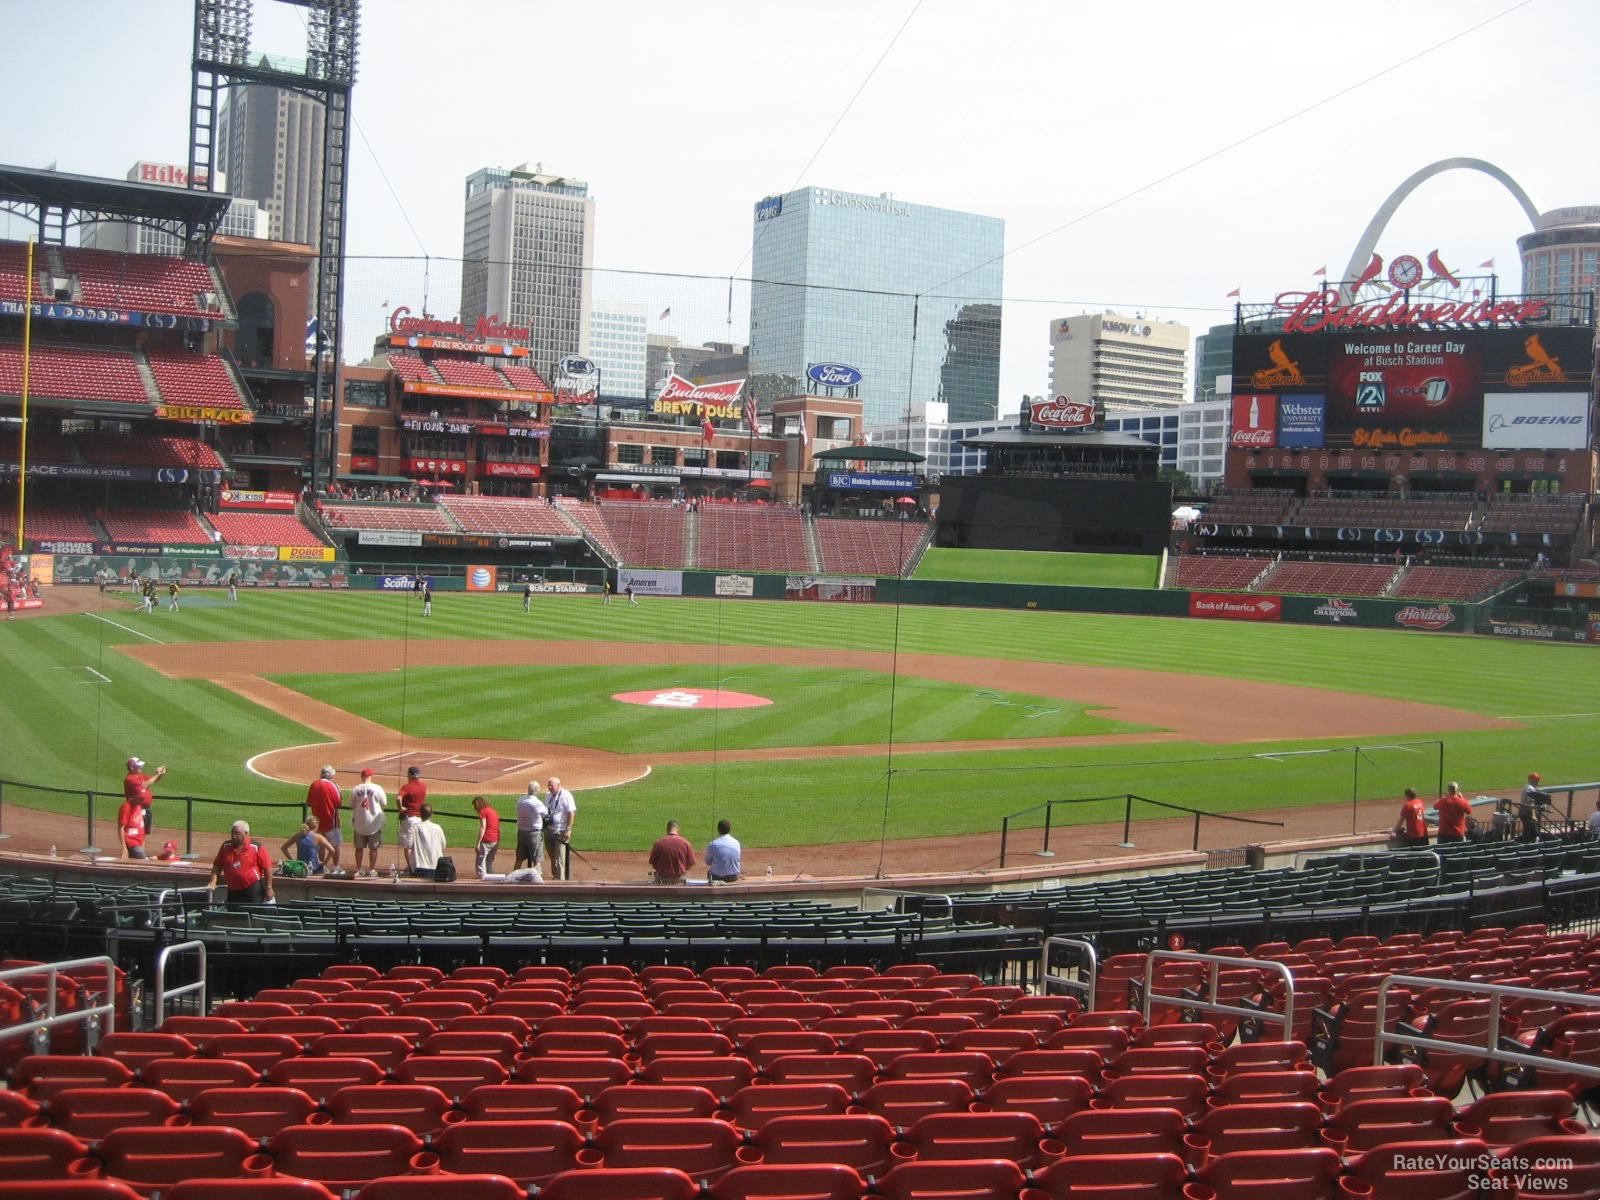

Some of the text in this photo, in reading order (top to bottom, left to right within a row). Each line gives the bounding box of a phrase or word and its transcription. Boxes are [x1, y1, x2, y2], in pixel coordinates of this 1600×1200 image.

[756, 205, 778, 220] KPMG
[48, 306, 55, 316] A
[64, 306, 118, 321] POWER
[1275, 291, 1547, 332] Budweiser
[390, 306, 529, 341] Cardinals Nation
[1102, 320, 1130, 333] KMOV
[432, 339, 489, 353] AT&T ROOFTOP
[1345, 341, 1465, 354] Welcome to Career Day
[567, 360, 587, 373] FOX
[1364, 355, 1443, 366] at Busch Stadium
[820, 366, 852, 383] Ford
[1360, 372, 1383, 382] FOX
[663, 384, 741, 401] Budweiser
[1364, 386, 1377, 404] 2
[167, 407, 241, 422] BIG MAC
[655, 401, 693, 415] BREW
[1039, 406, 1085, 422] Coca-Cola
[1282, 404, 1322, 415] Webster
[1511, 416, 1584, 425] BOEING
[833, 476, 847, 486] BJC
[383, 576, 427, 588] Scottra
[627, 578, 656, 587] Ameren
[1196, 601, 1215, 609] Bank
[1224, 603, 1255, 612] America
[1313, 609, 1357, 617] CHAMPIONS
[1494, 627, 1518, 635] BUSCH
[1520, 628, 1553, 637] STADIUM
